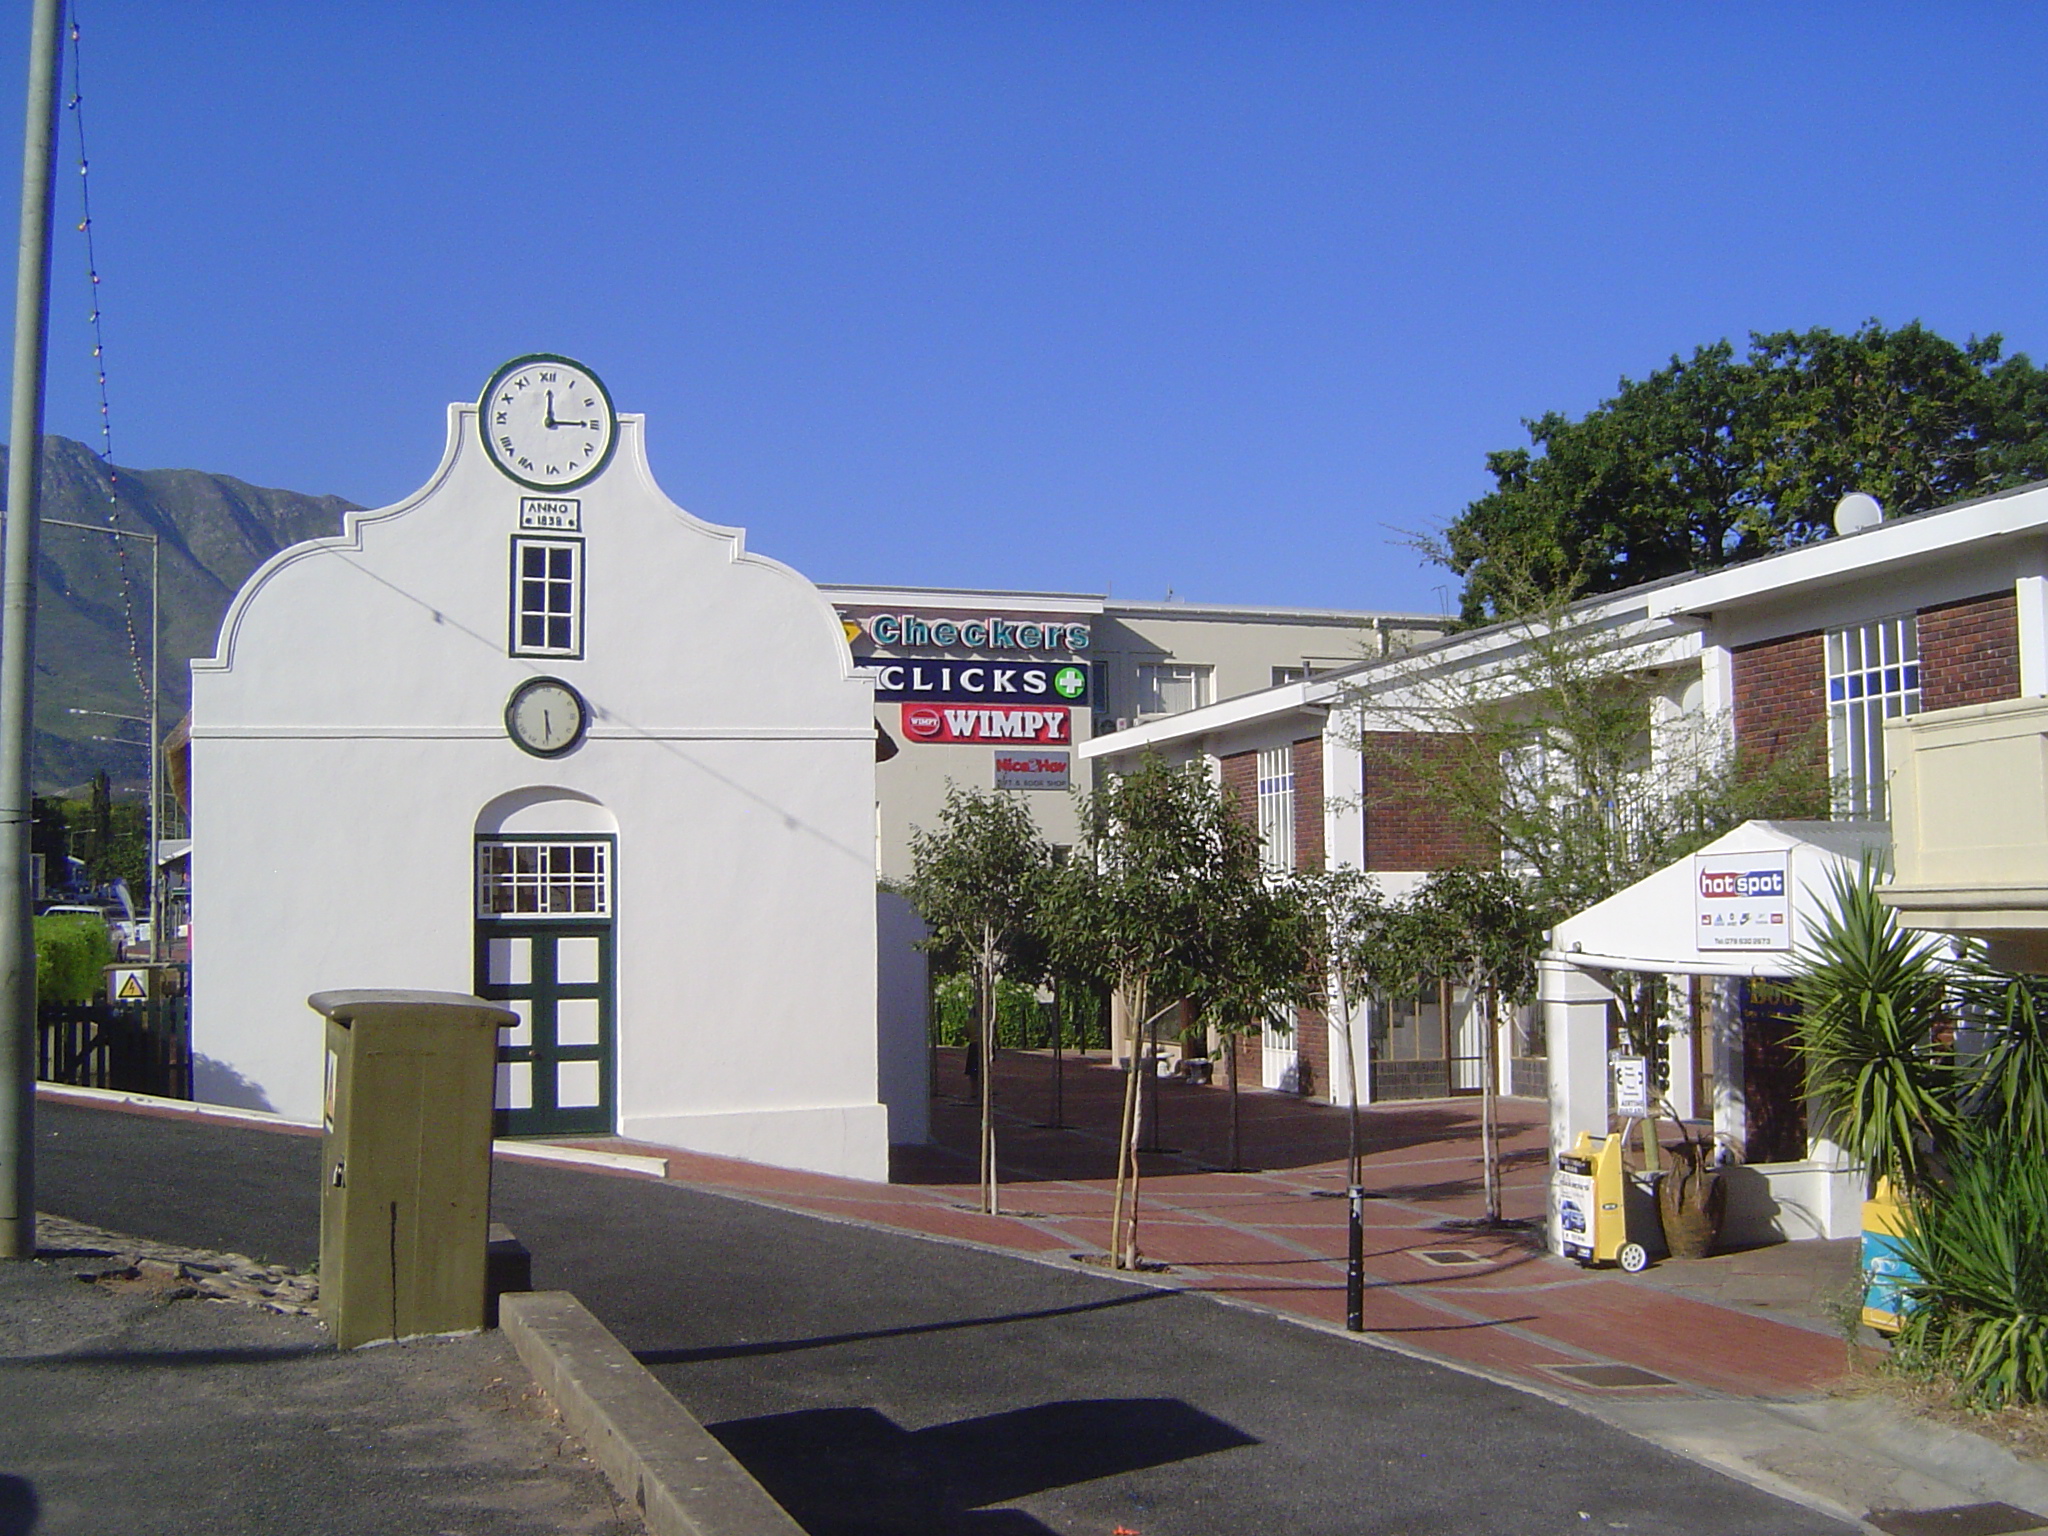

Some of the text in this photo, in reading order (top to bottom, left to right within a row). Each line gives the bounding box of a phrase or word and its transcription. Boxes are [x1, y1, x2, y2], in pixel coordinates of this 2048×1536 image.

[515, 376, 530, 391] XI
[539, 372, 556, 383] XII
[501, 393, 514, 405] X
[528, 502, 568, 514] ANNO
[869, 612, 1090, 651] Checkers
[879, 665, 1048, 694] CLICKS
[910, 716, 939, 727] WIMPY
